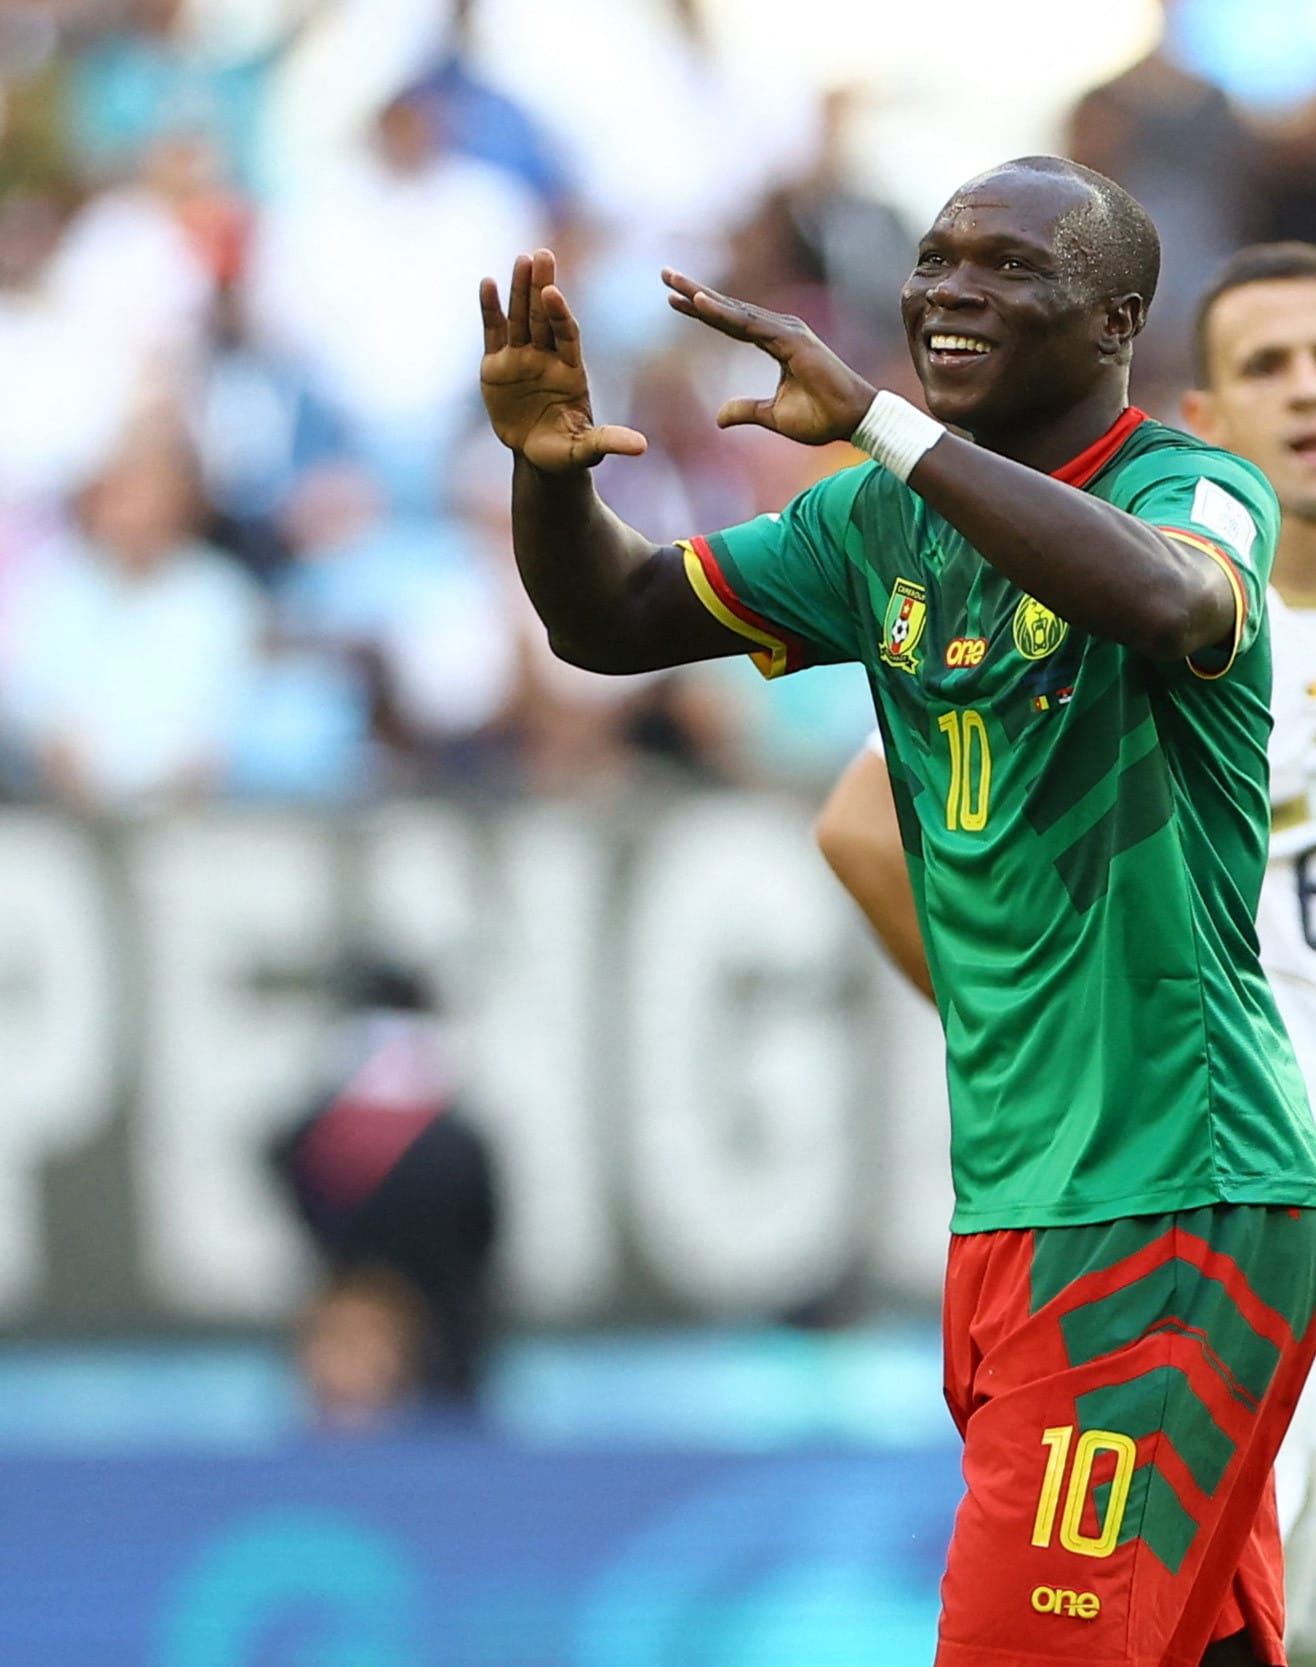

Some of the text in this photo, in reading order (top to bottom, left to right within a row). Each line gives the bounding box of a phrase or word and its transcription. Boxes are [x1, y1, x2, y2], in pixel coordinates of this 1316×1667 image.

[946, 640, 986, 666] one
[937, 709, 992, 832] 10
[1031, 1425, 1137, 1559] 10
[1031, 1585, 1101, 1620] one
